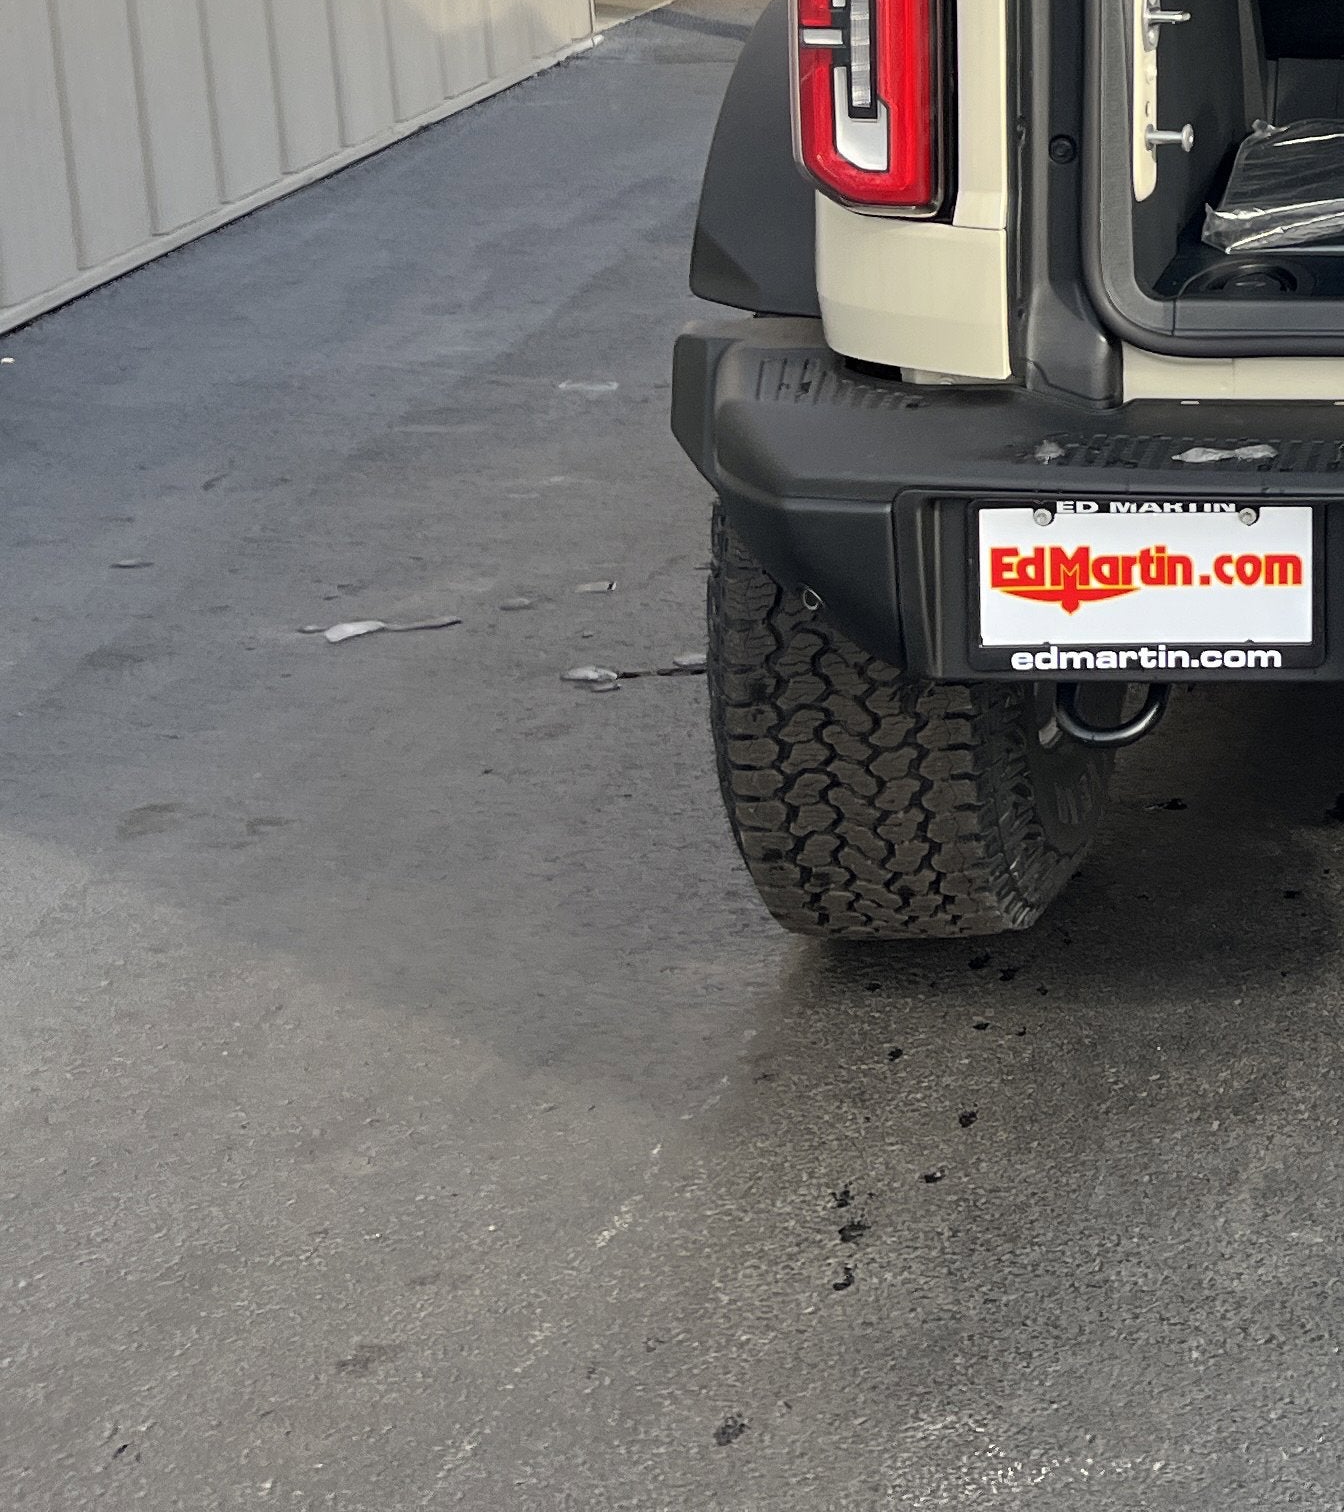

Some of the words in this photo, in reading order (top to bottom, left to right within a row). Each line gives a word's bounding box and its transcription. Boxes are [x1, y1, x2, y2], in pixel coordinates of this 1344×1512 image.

[1056, 500, 1099, 514] ED
[990, 545, 1303, 587] EdMartin.com
[1011, 645, 1282, 671] edmartin.com
